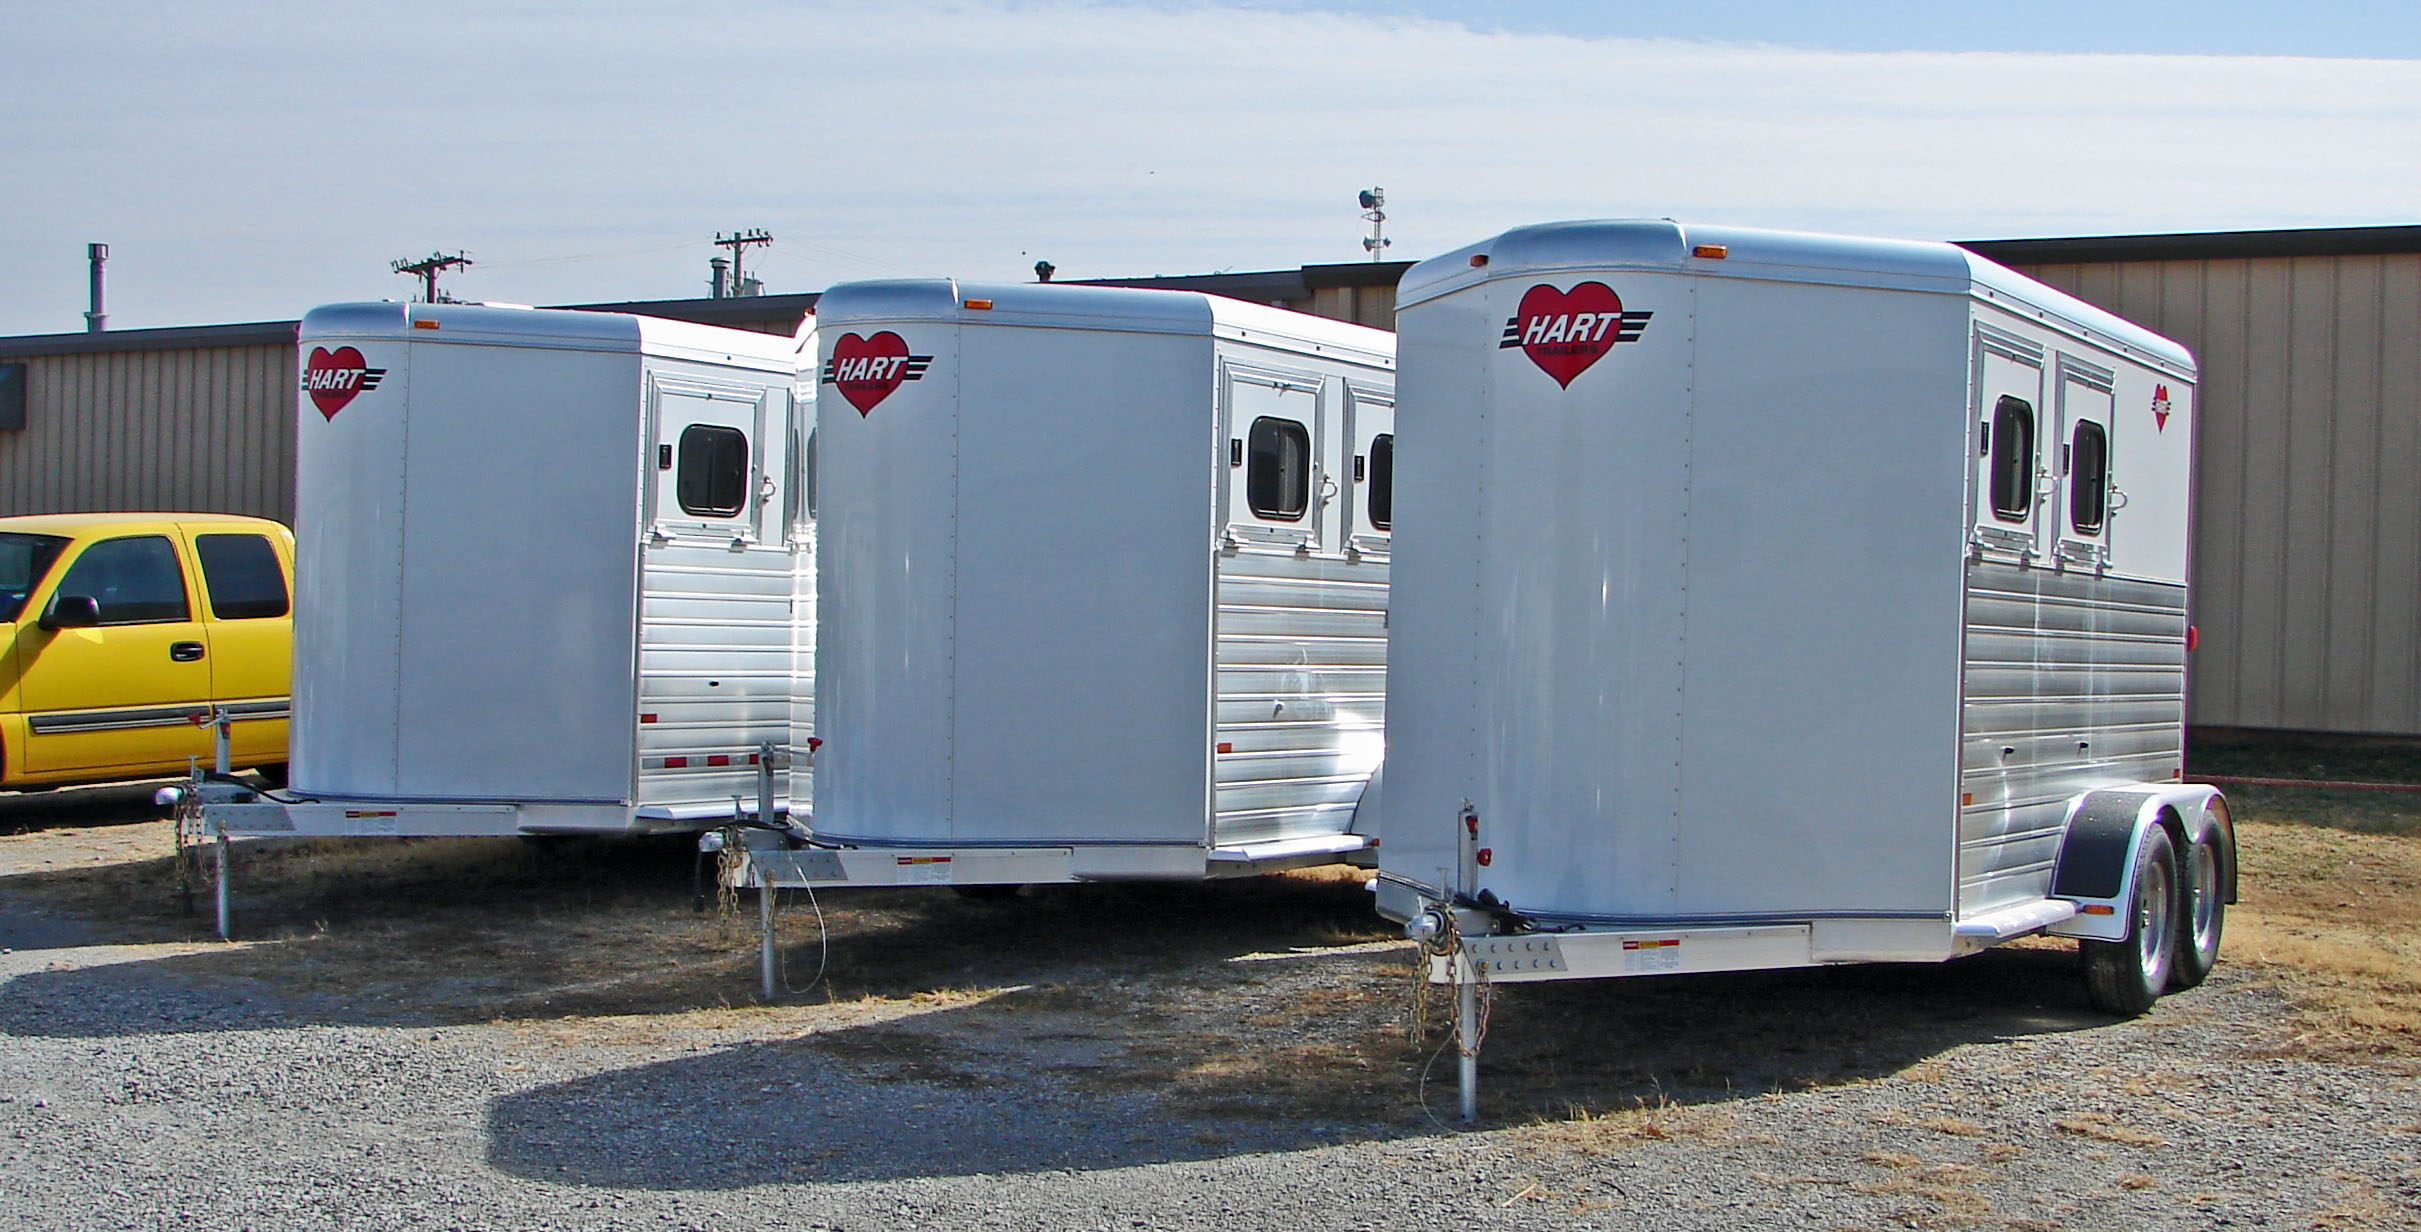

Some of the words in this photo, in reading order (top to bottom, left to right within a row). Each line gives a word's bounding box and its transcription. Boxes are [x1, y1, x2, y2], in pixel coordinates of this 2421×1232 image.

[1521, 312, 1622, 345] HART
[308, 368, 366, 390] HART
[835, 355, 909, 382] HART
